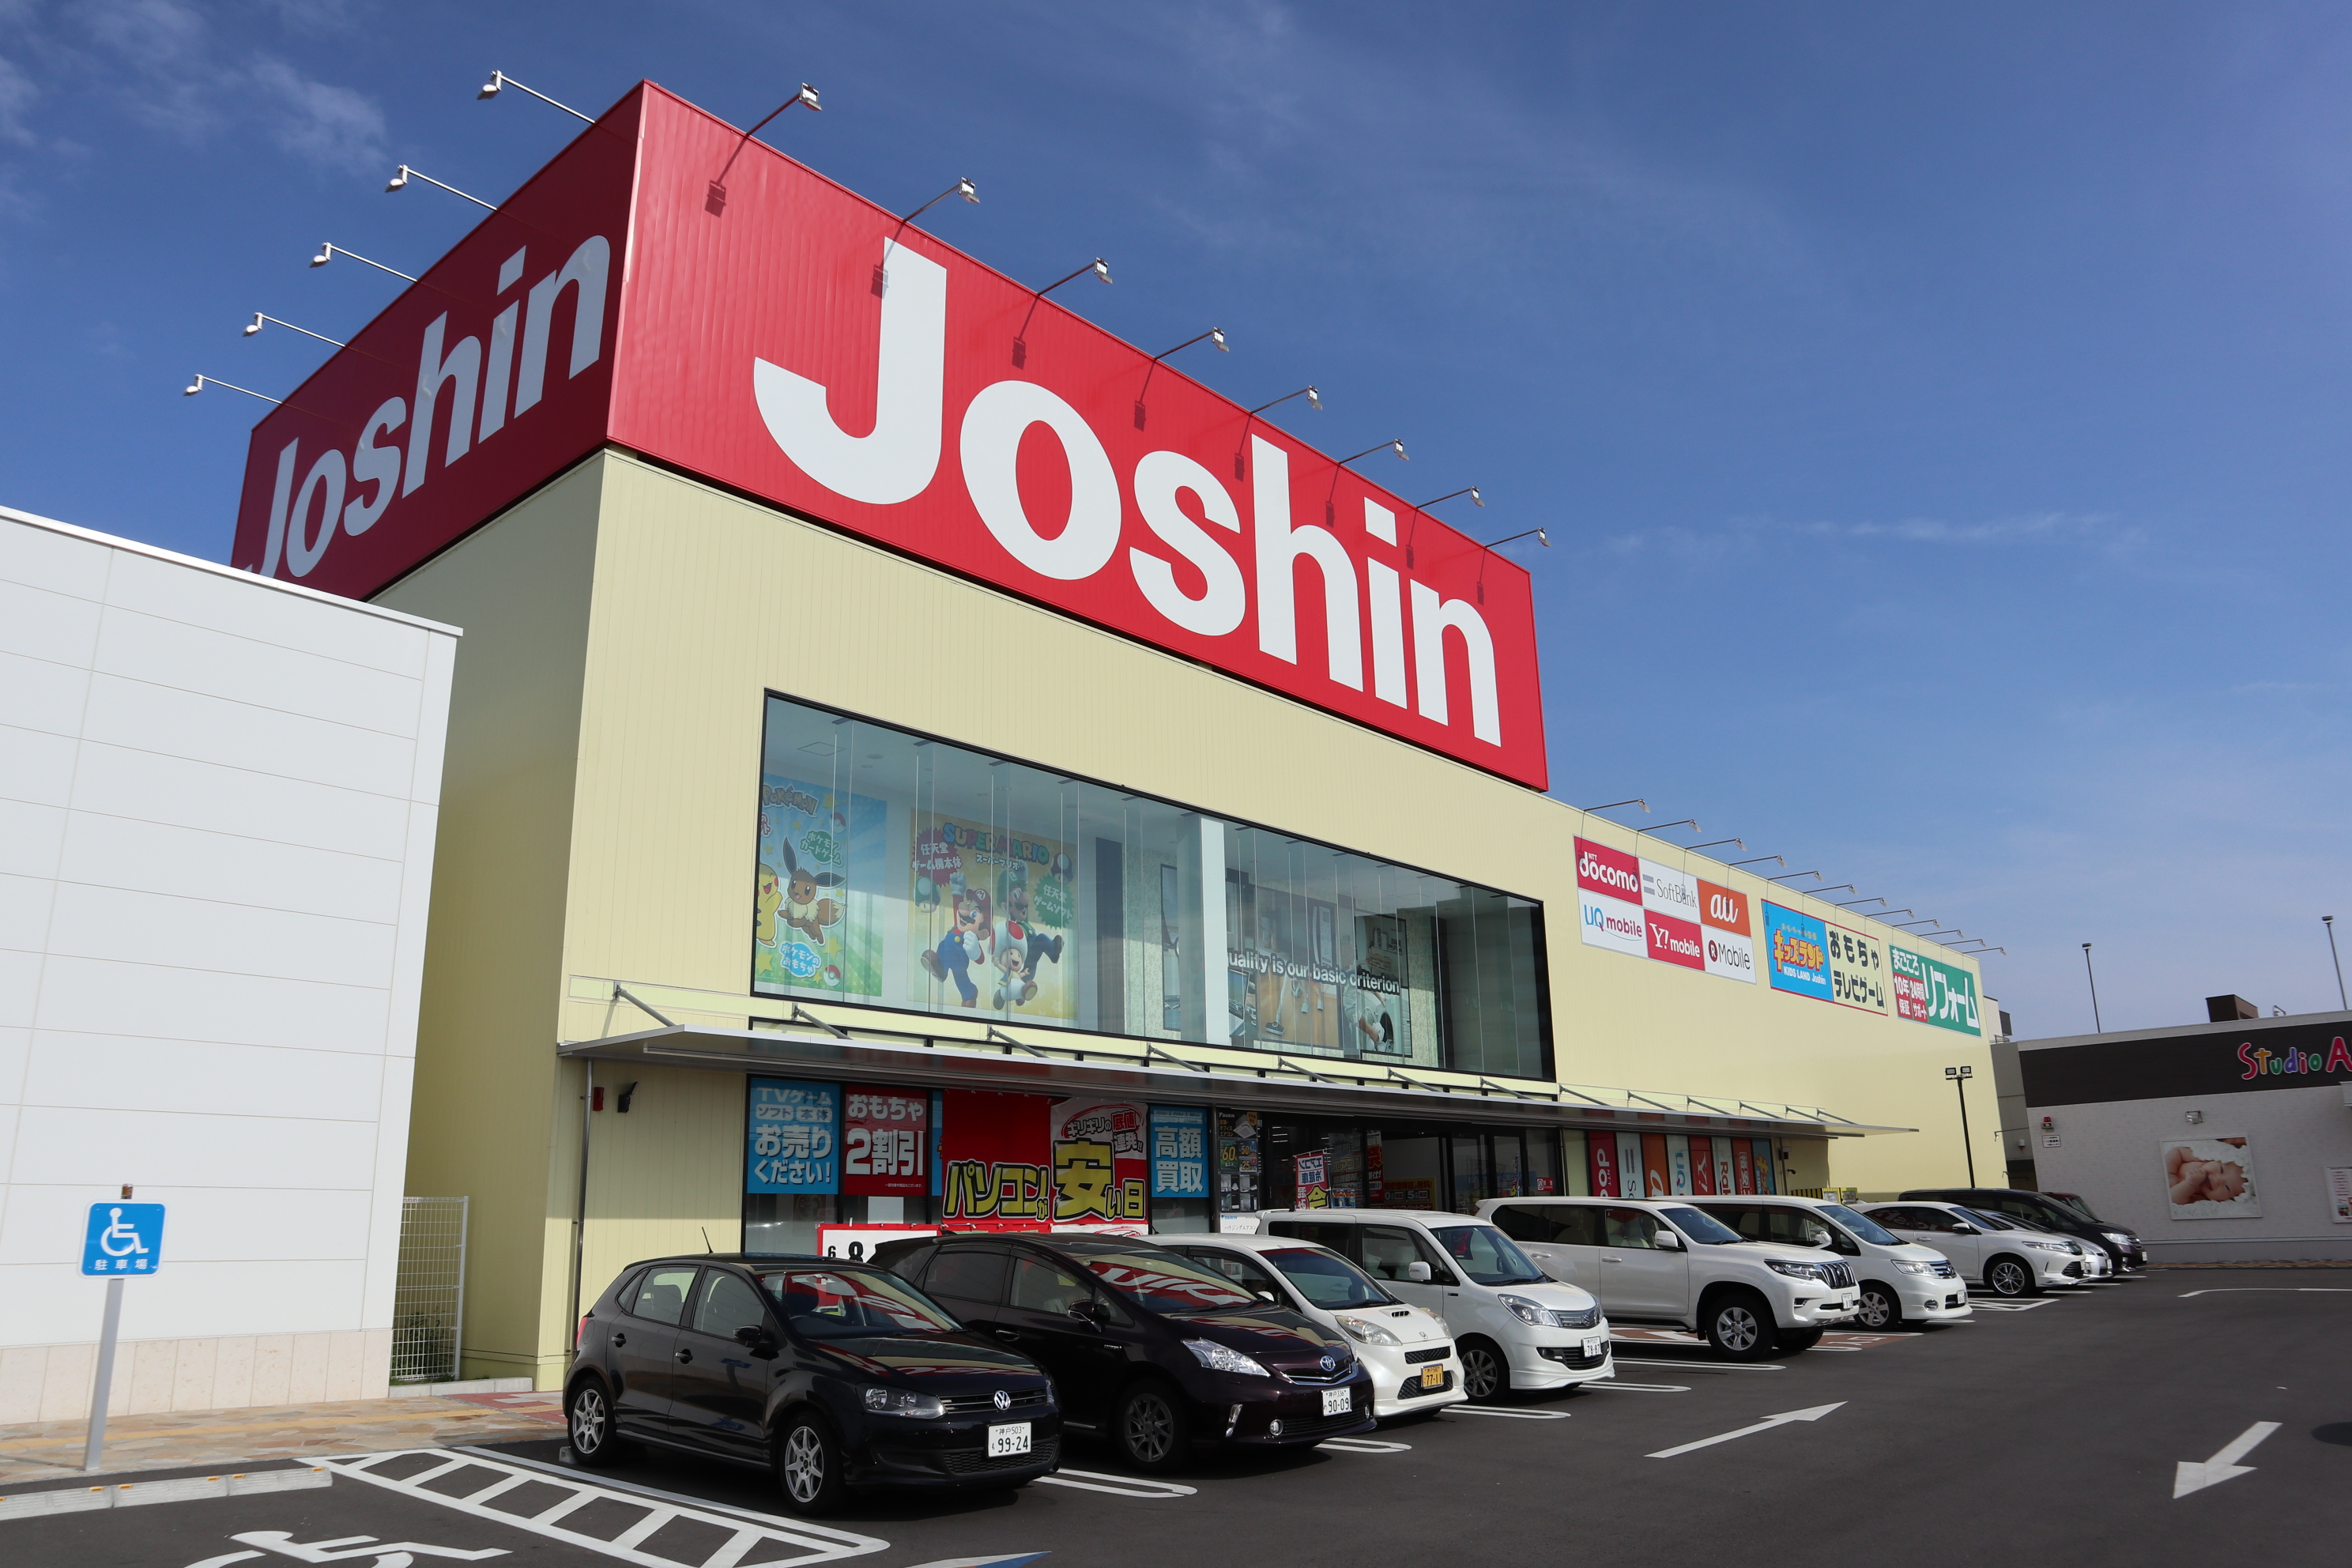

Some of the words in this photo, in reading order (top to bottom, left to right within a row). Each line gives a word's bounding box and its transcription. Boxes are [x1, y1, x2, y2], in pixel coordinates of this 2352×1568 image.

[244, 235, 610, 579] Joshin
[753, 236, 1502, 748] Joshin
[801, 839, 842, 865] カードゲーム
[808, 831, 838, 850] ポケモン
[920, 842, 948, 856] 任天堂
[942, 823, 997, 853] SUPER
[996, 835, 1050, 865] MARIO
[912, 857, 963, 871] ゲーム機本体
[975, 854, 1020, 870] スーパーマリオ
[1579, 851, 1638, 892] docomo
[1043, 884, 1068, 903] 任天堂
[1657, 879, 1698, 908] SoftBank
[1584, 904, 1604, 932] UQ
[1606, 917, 1642, 937] mobile
[1710, 894, 1738, 923] au
[1649, 922, 1669, 949] Y!
[1670, 938, 1701, 958] mobile
[1773, 929, 1825, 973] キッズランド
[1829, 930, 1879, 971] おもちゃ
[782, 944, 820, 965] ポケモンの
[783, 956, 814, 974] おもちゃ
[1718, 943, 1751, 971] Mobile
[1891, 948, 1920, 976] まごころ
[1227, 951, 1270, 974] uality
[1272, 953, 1284, 974] is
[1287, 962, 1309, 978] our
[1313, 963, 1347, 985] basic
[1349, 971, 1400, 994] criterion
[1784, 966, 1796, 979] KIDS
[1796, 969, 1811, 982] LAND
[1811, 971, 1826, 986] Joshin
[1833, 971, 1885, 1008] テレビゲーム
[1894, 976, 1909, 997] 10年
[1909, 979, 1925, 1001] 24時間
[1921, 963, 1980, 1028] リフォーム
[1898, 1000, 1911, 1016] 保証
[2237, 1042, 2322, 1080] Studio
[2326, 1036, 2352, 1072] A
[756, 1086, 833, 1105] TVゲーム
[847, 1094, 924, 1121] おもちゃ
[758, 1107, 791, 1119] ソフト
[801, 1108, 829, 1120] 本体
[1067, 1110, 1136, 1137] ギリギリの底値
[755, 1124, 833, 1159] お売り
[846, 1128, 924, 1176] 2割引
[1154, 1126, 1203, 1159] 高額
[754, 1159, 831, 1185] ください!
[1155, 1160, 1204, 1193] 買取
[1675, 1152, 1686, 1189] UQ
[1720, 1161, 1732, 1195] Ra
[1626, 1180, 1637, 1199] So
[94, 1258, 149, 1271] 駐車場
[1427, 1373, 1442, 1385] 77-11
[1328, 1397, 1349, 1413] 90-09
[997, 1435, 1028, 1453] 99-24
[999, 1426, 1022, 1435] 神戸503
